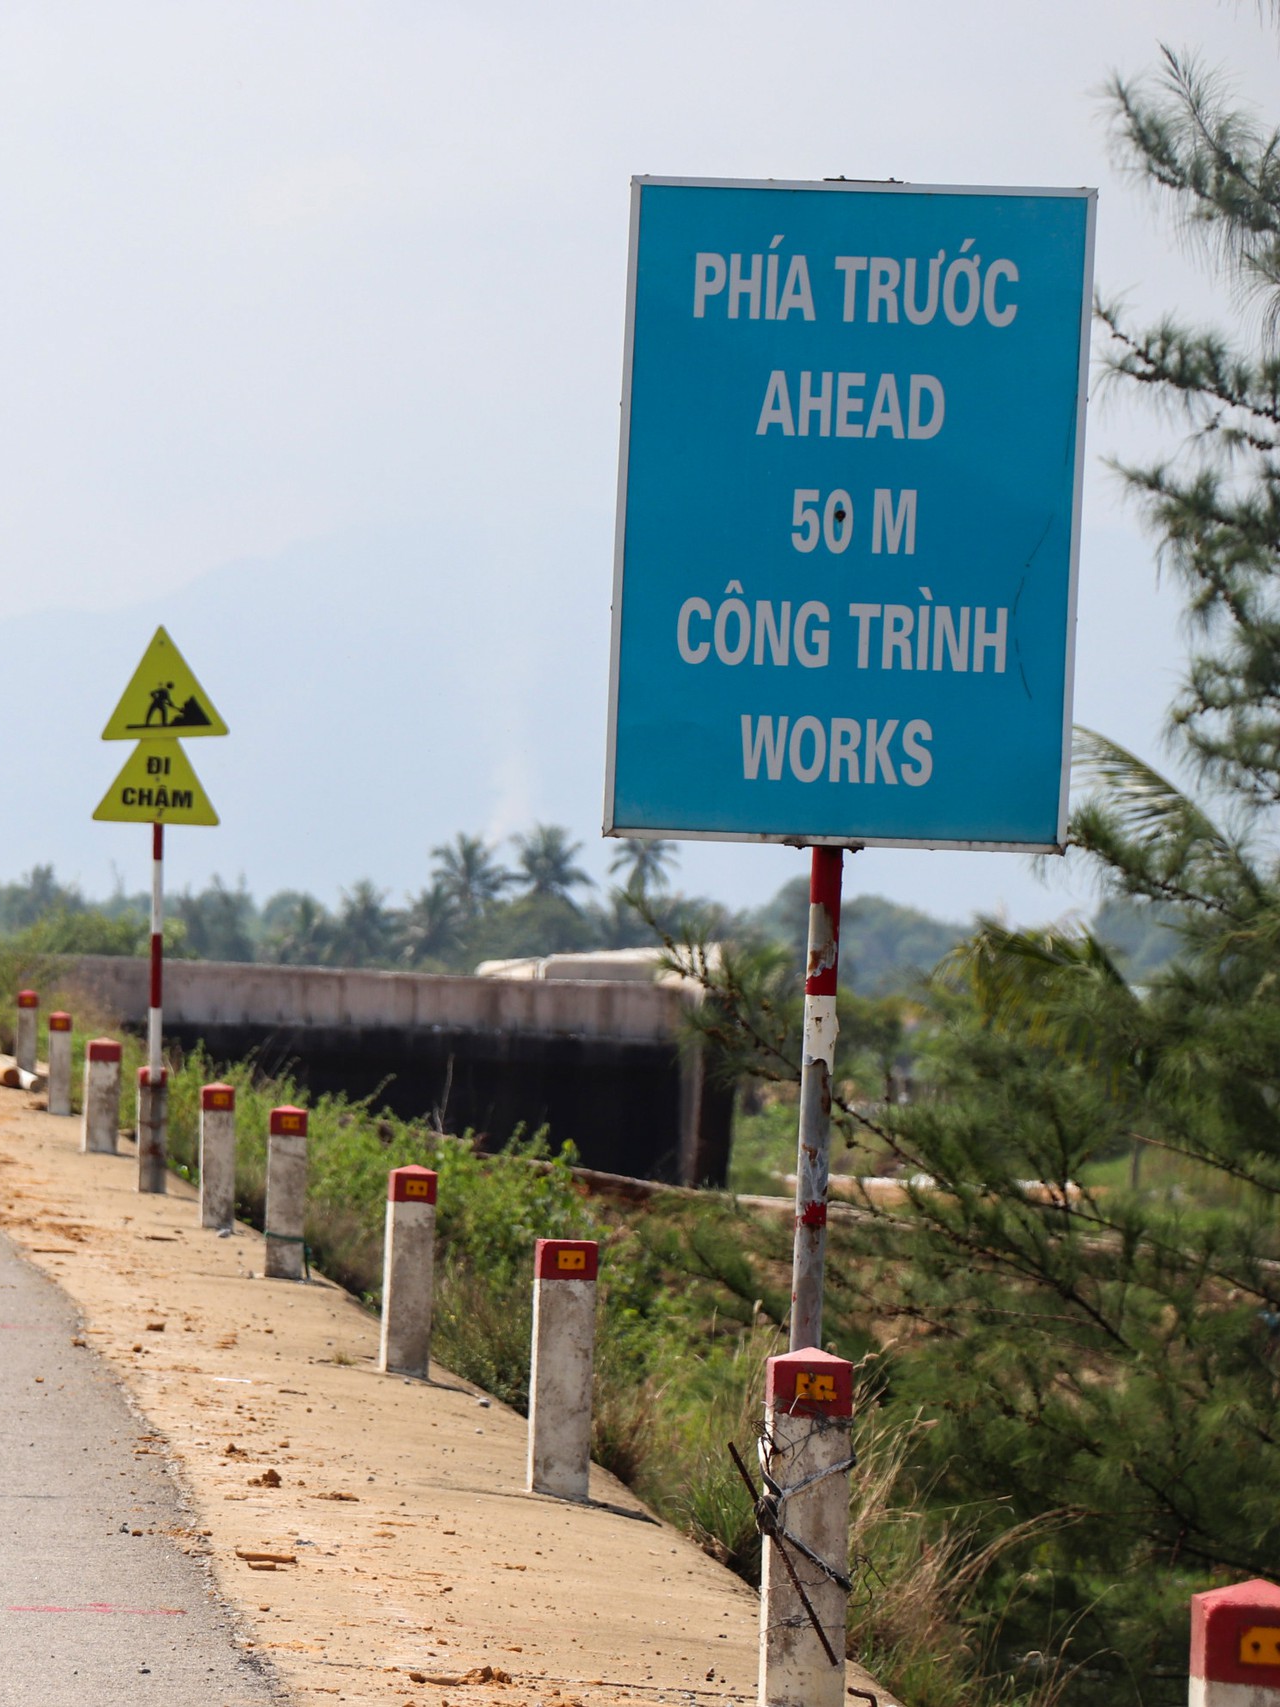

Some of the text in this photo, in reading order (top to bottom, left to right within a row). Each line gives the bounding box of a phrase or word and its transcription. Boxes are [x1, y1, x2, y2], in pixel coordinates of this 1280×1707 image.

[693, 234, 1020, 328] PHÍA TRƯỚC
[755, 369, 946, 440] AHEAD
[791, 488, 918, 555] 50 M
[676, 579, 1008, 674] CÔNG TRÌNH
[740, 714, 934, 787] WORKS
